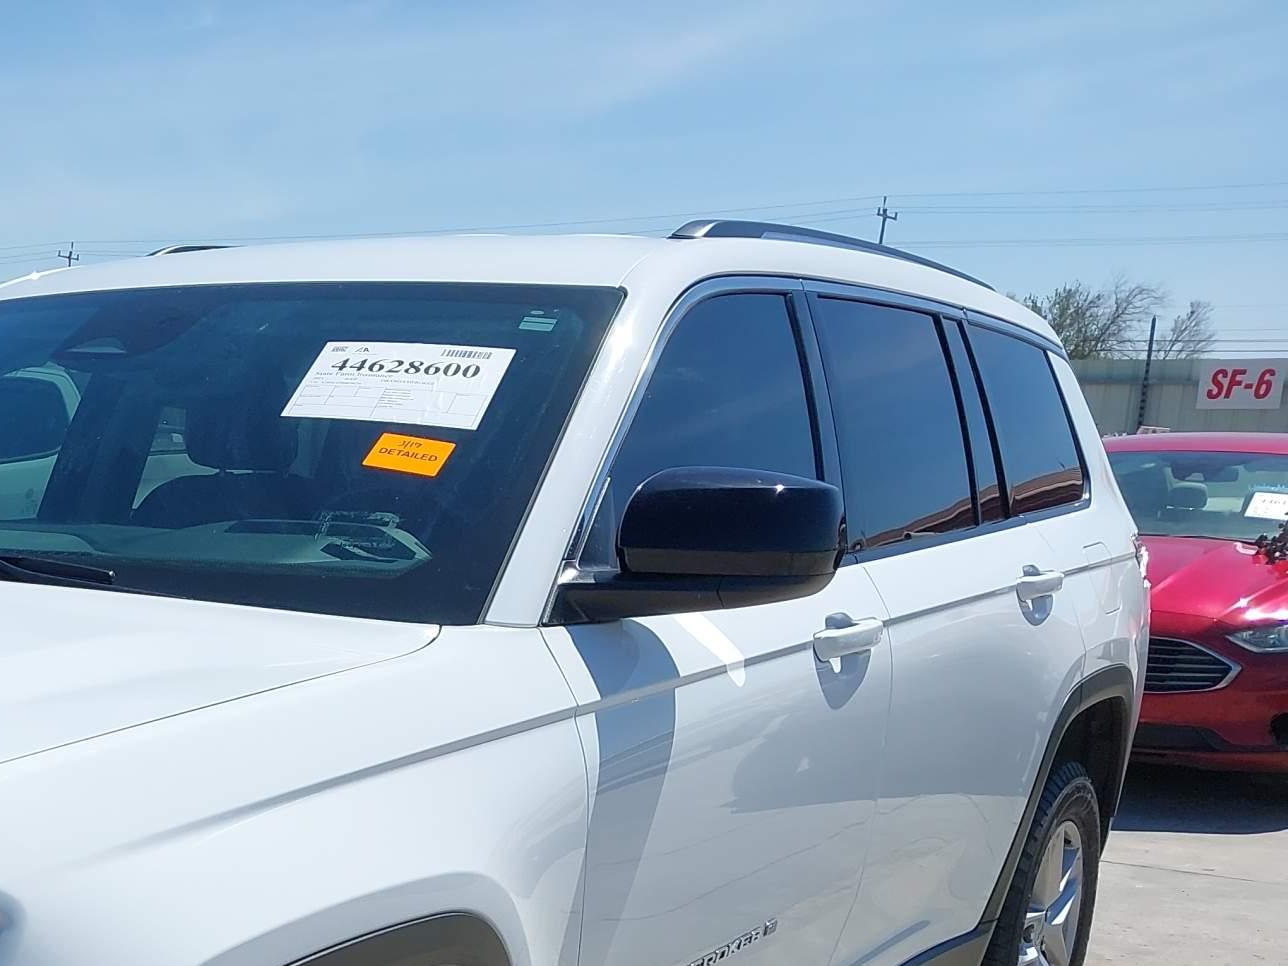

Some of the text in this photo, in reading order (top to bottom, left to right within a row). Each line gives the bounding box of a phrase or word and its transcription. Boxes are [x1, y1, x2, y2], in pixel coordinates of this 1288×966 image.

[331, 357, 481, 379] 44628600
[1206, 368, 1276, 400] SF-6
[378, 447, 438, 462] DETAILED
